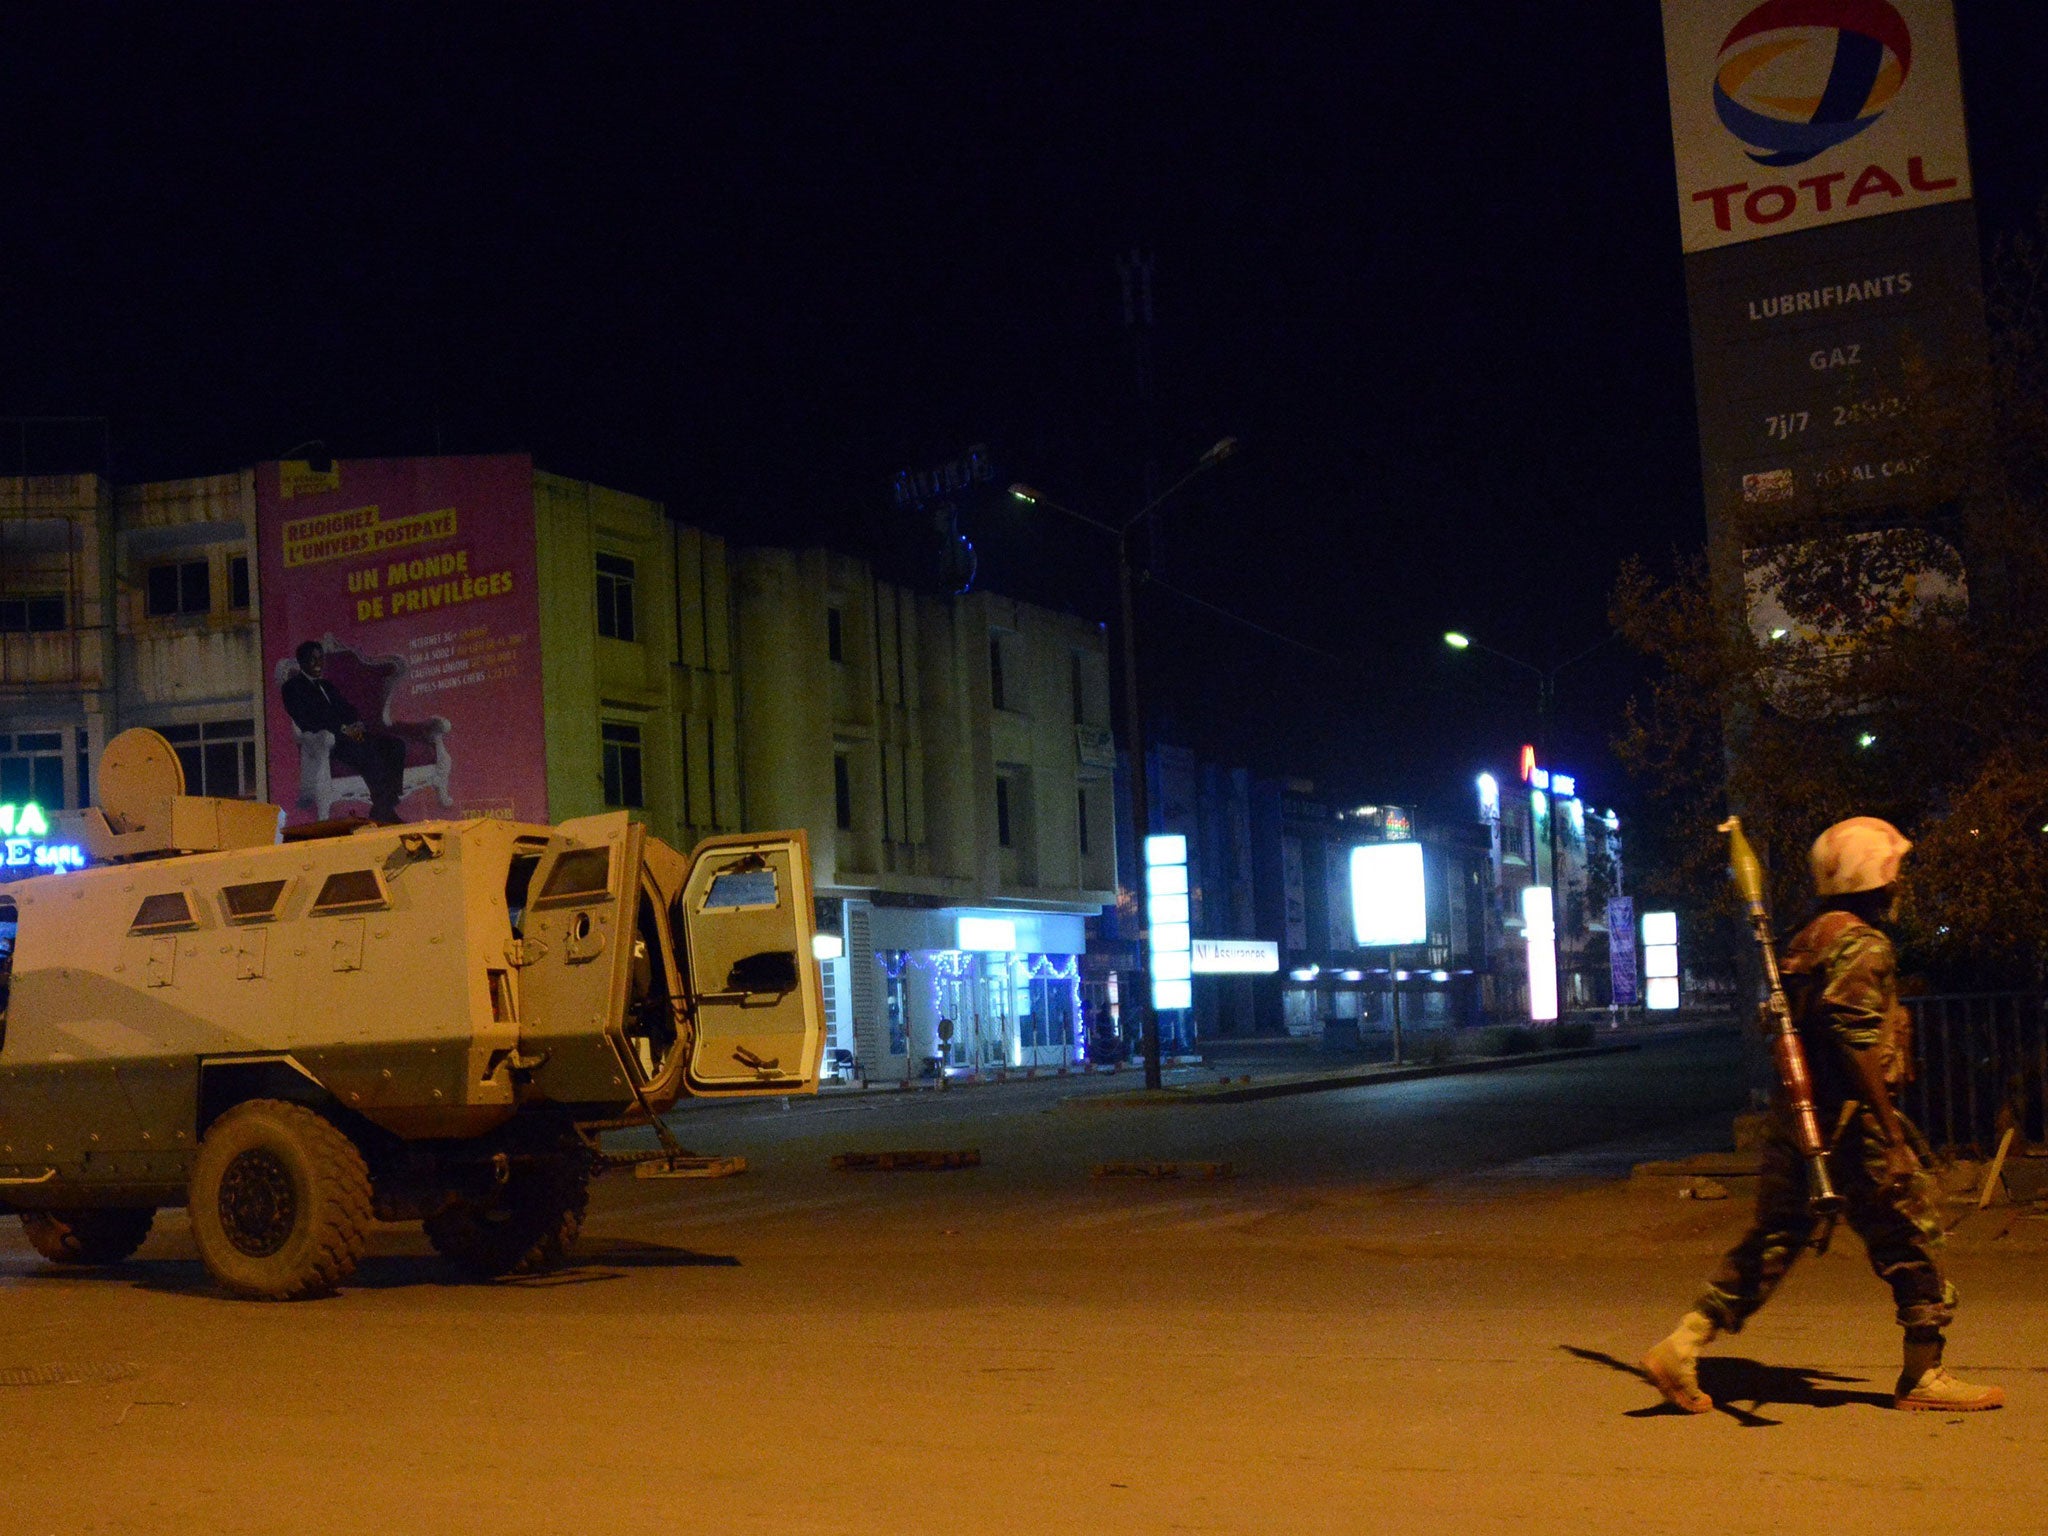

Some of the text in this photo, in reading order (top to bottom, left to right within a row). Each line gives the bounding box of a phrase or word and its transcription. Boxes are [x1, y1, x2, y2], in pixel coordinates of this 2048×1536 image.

[1692, 156, 1957, 231] TOTAL
[1750, 273, 1912, 320] LUBRIFIANTS
[1809, 344, 1862, 370] GAZ
[1765, 411, 1809, 440] 7j/7
[288, 510, 372, 541] REJOIGNEZ
[289, 532, 369, 563] L'UNIVERS
[349, 551, 468, 592] UN MONDE
[358, 570, 513, 622] DE PRIVILÈGES
[34, 845, 84, 867] SARL
[1214, 944, 1266, 959] Assurances
